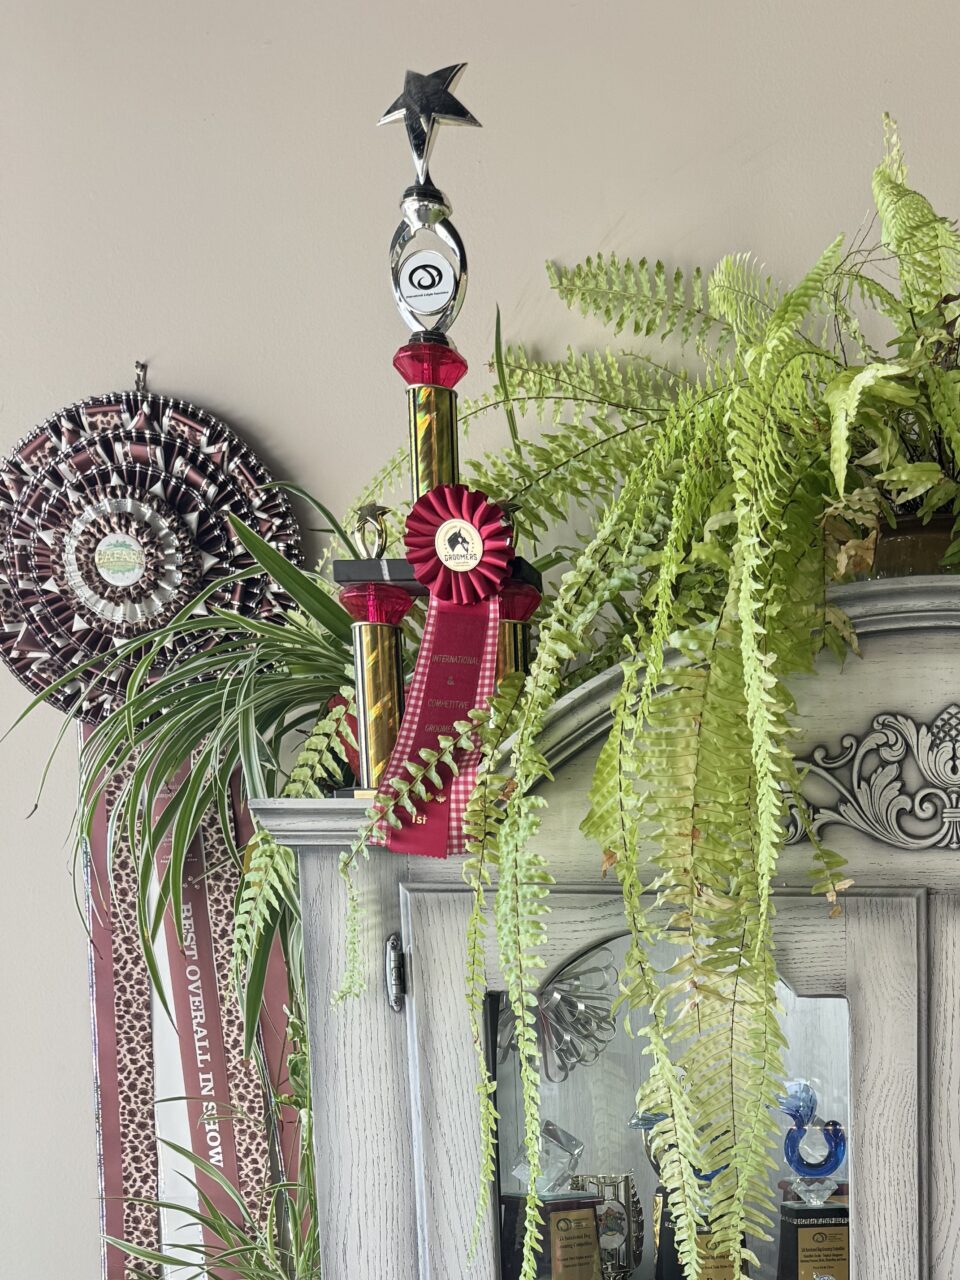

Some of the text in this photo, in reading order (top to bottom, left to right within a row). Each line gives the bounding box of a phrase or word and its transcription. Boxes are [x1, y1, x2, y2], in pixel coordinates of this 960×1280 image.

[444, 553, 478, 562] GROOMERS
[432, 655, 480, 664] INTERNATIONAL
[447, 676, 455, 685] &
[428, 699, 470, 709] COMPETITIVE
[411, 814, 428, 825] 1st
[180, 902, 224, 1168] BEST OVERALL IN SHOW
